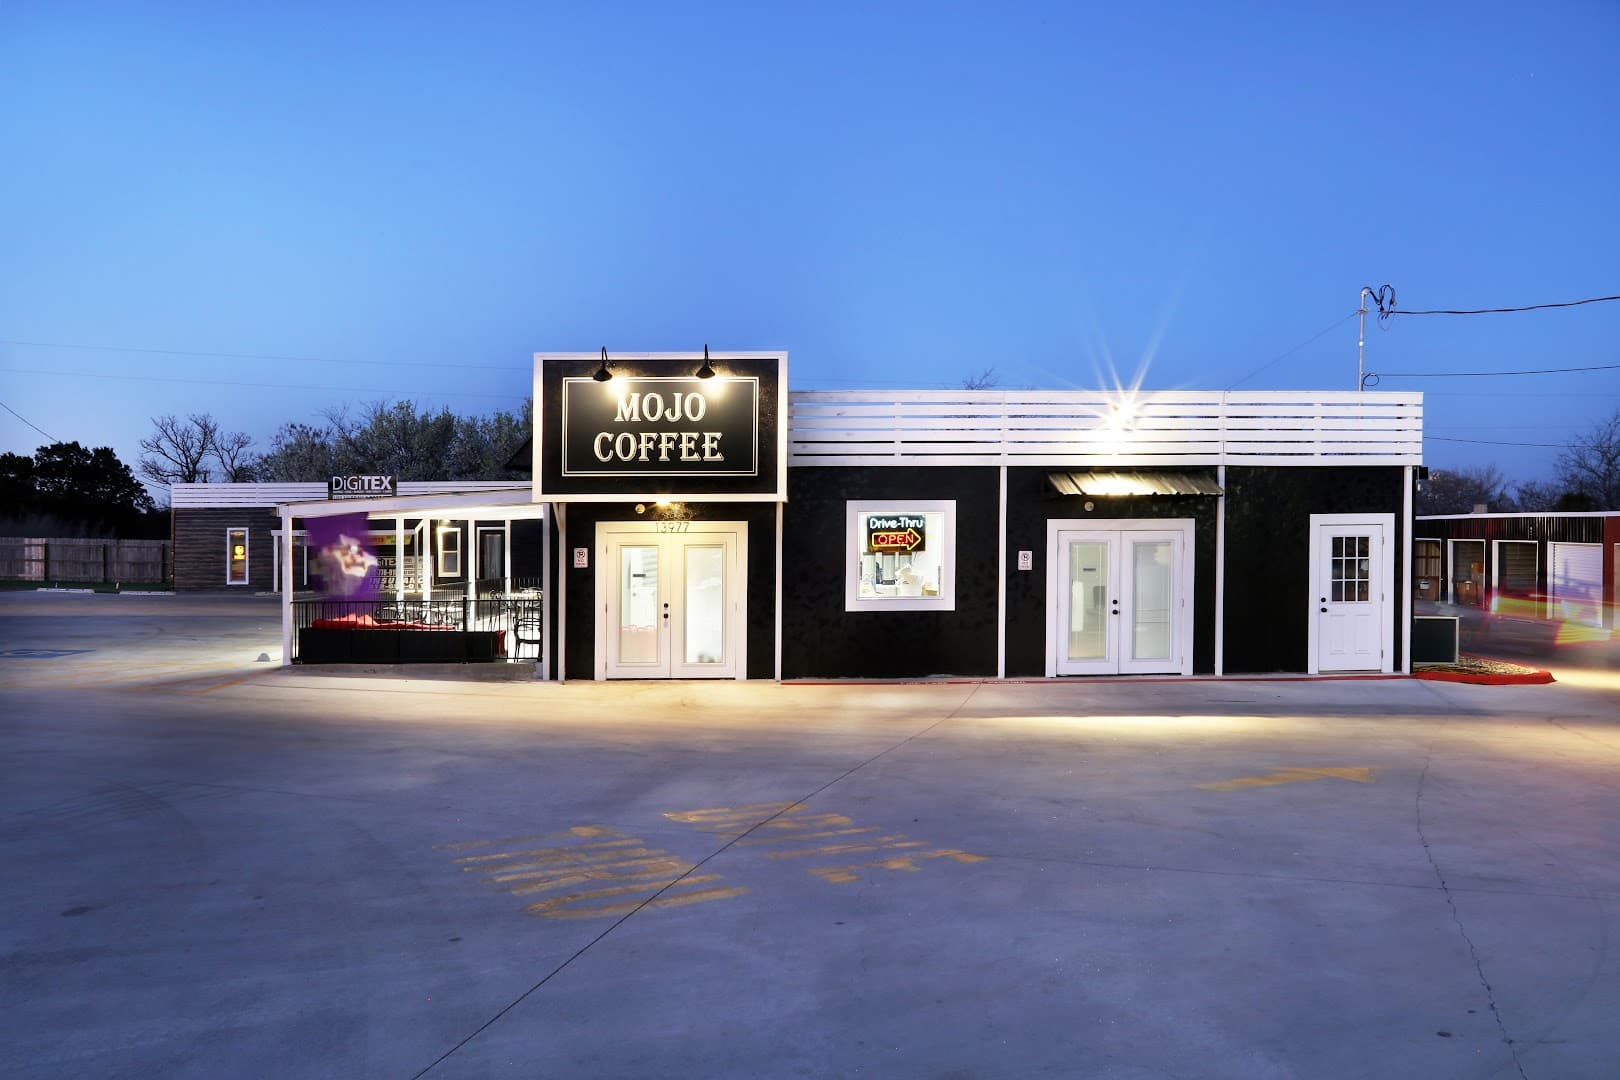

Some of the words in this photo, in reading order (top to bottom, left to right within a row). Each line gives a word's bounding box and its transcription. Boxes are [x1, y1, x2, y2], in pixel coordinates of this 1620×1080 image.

[614, 392, 707, 423] MOJO
[593, 431, 725, 462] COFFEE
[332, 475, 392, 490] DiGiTEX
[656, 521, 690, 533] 13977
[869, 516, 924, 529] Drive-Thru
[878, 534, 914, 545] OPEN
